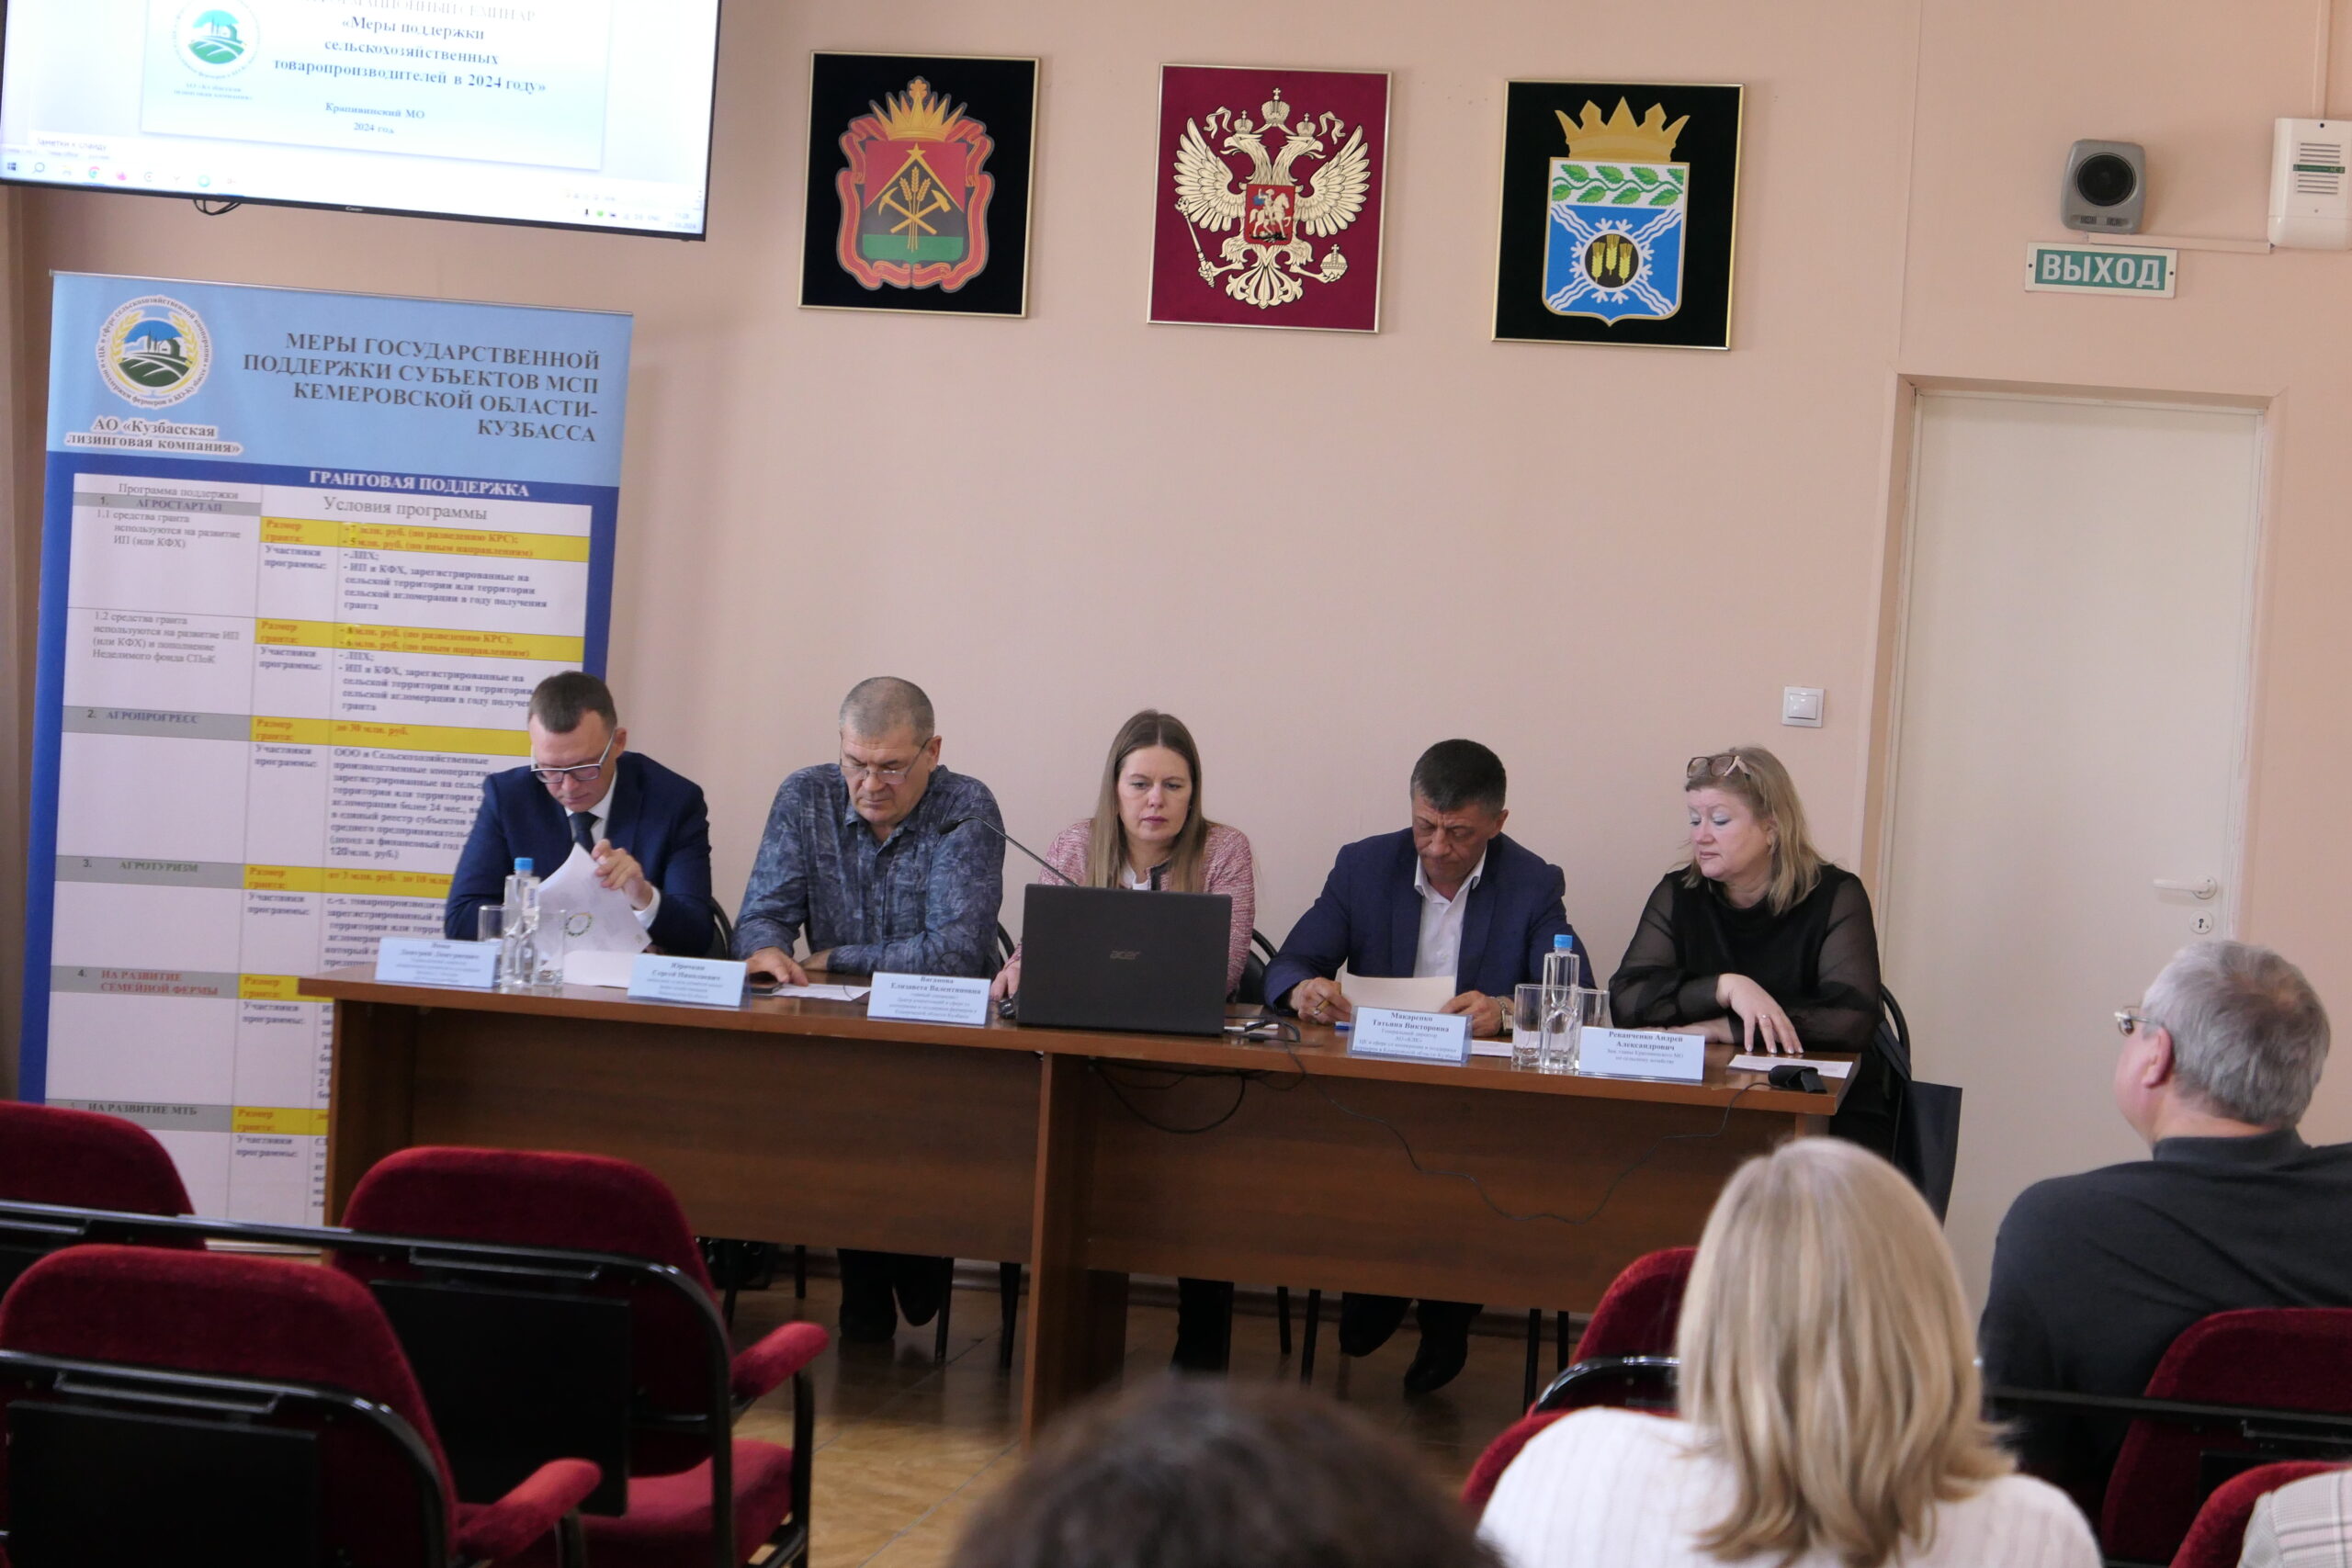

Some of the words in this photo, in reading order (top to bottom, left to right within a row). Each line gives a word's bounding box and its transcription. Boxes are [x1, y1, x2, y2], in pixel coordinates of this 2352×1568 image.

[342, 16, 396, 34] «Меры
[401, 22, 484, 39] поддержки
[324, 39, 499, 65] сельскохозяйственных
[274, 59, 447, 85] товаропроизводителей
[454, 76, 462, 85] в
[468, 73, 502, 88] 2024
[505, 79, 546, 95] году»
[325, 102, 401, 118] Крапивинский
[405, 109, 424, 119] МО
[354, 121, 375, 131] 2024
[2042, 254, 2159, 288] ВЫХОД
[287, 333, 356, 353] МЕРЫ
[365, 338, 600, 370] ГОСУДАРСТВЕННОЙ
[243, 355, 391, 380] ПОДДЕРЖКИ
[399, 364, 538, 389] СУБЪЕКТОВ
[546, 375, 598, 394] МСП
[294, 382, 472, 410] КЕМЕРОВСКОЙ
[480, 394, 597, 417] ОБЛАСТИ-
[94, 418, 118, 431] АО
[123, 420, 215, 438] «Кузбасская
[478, 419, 596, 442] КУЗБАССА
[67, 434, 153, 448] лизинговая
[158, 439, 241, 453] компания»
[309, 470, 414, 491] ГРАНТОВАЯ
[419, 479, 528, 497] ПОДДЕРЖКА
[119, 484, 177, 495] Программа
[181, 489, 239, 500] поддержки
[100, 496, 108, 505] 1.
[137, 500, 222, 512] АГРОСТАРТАП
[323, 496, 392, 515] Условия
[396, 504, 487, 522] программы
[97, 510, 109, 518] 1.1
[113, 512, 155, 522] средства
[158, 514, 189, 523] гранта
[115, 525, 181, 536] используются
[114, 536, 130, 544] ИП
[132, 536, 153, 546] (или
[157, 538, 186, 548] КФХ)
[266, 545, 321, 557] Участники
[265, 559, 326, 570] программы:
[95, 612, 108, 620] 1.2
[111, 614, 153, 624] средства
[155, 616, 187, 625] гранта
[94, 625, 161, 636] используются
[177, 630, 219, 639] развитие
[222, 632, 239, 640] ИП
[93, 637, 115, 646] (или
[118, 637, 146, 648] КФХ)
[157, 641, 214, 651] пополнение
[93, 649, 151, 660] Неделимого
[153, 653, 183, 663] фонда
[186, 654, 216, 664] СПоК
[107, 711, 198, 724] АГРОПРОГРЕСС
[84, 859, 92, 867] 3.
[119, 862, 198, 873] АГРОТУРИЗМ
[78, 969, 87, 977] 4.
[102, 970, 118, 979] НА
[121, 971, 182, 981] РАЗВИТИЕ
[101, 982, 169, 993] СЕМЕЙНОЙ
[173, 987, 218, 995] ФЕРМЫ
[891, 983, 927, 991] Елизавета
[1391, 1012, 1433, 1022] Макаренко
[1374, 1020, 1403, 1028] Татьяна
[1405, 1021, 1449, 1032] Викторовна
[1656, 1034, 1683, 1043] Андрей
[1617, 1042, 1674, 1051] Александрович
[88, 1103, 105, 1112] НА
[107, 1104, 167, 1115] РАЗВИТИЕ
[173, 1106, 197, 1116] МТБ
